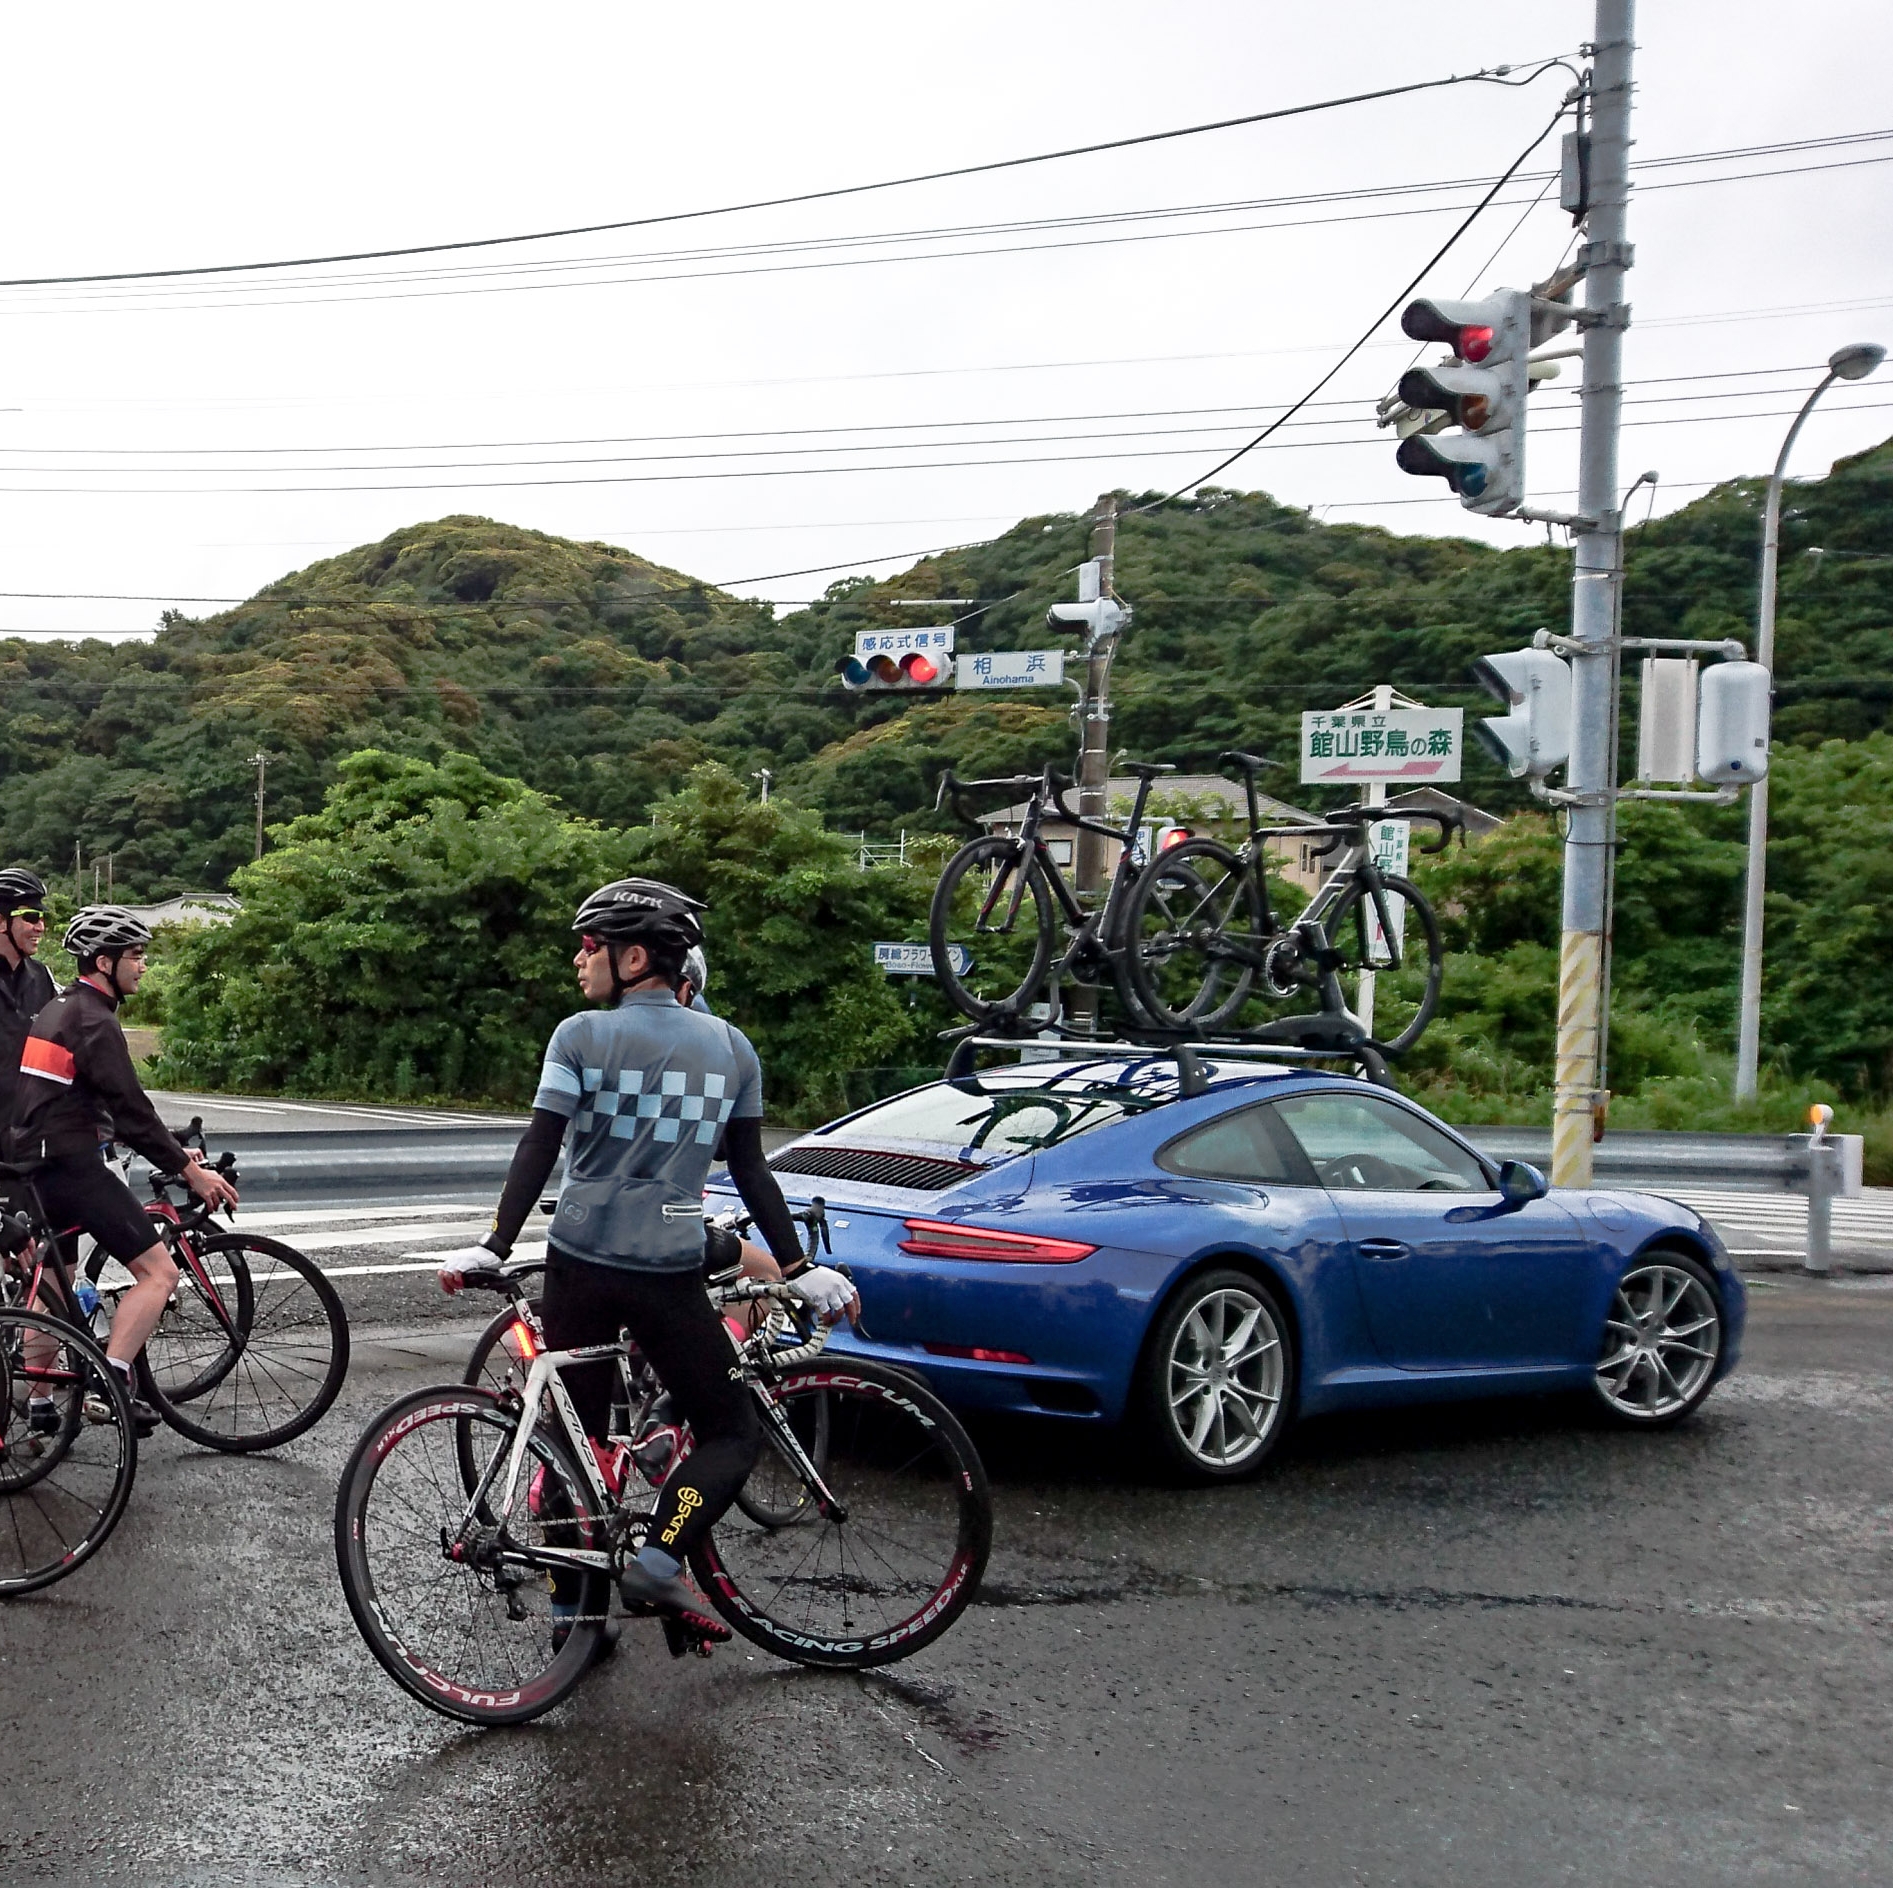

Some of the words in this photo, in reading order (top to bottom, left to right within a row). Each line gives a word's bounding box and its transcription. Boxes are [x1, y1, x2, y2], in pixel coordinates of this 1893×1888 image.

[861, 632, 947, 650] 感応式信号
[973, 655, 1046, 675] 相浜
[983, 675, 1035, 685] Ainohama
[1311, 715, 1387, 728] 千葉県立
[1310, 728, 1453, 758] 館山野鳥の森
[613, 892, 664, 909] KASK
[395, 1402, 479, 1434] SPEED
[660, 1502, 692, 1546] SKINS
[730, 1595, 864, 1653] RACING
[868, 1588, 953, 1650] SPEED
[951, 1563, 969, 1592] XLR
[368, 1599, 521, 1707] FULCRUM
